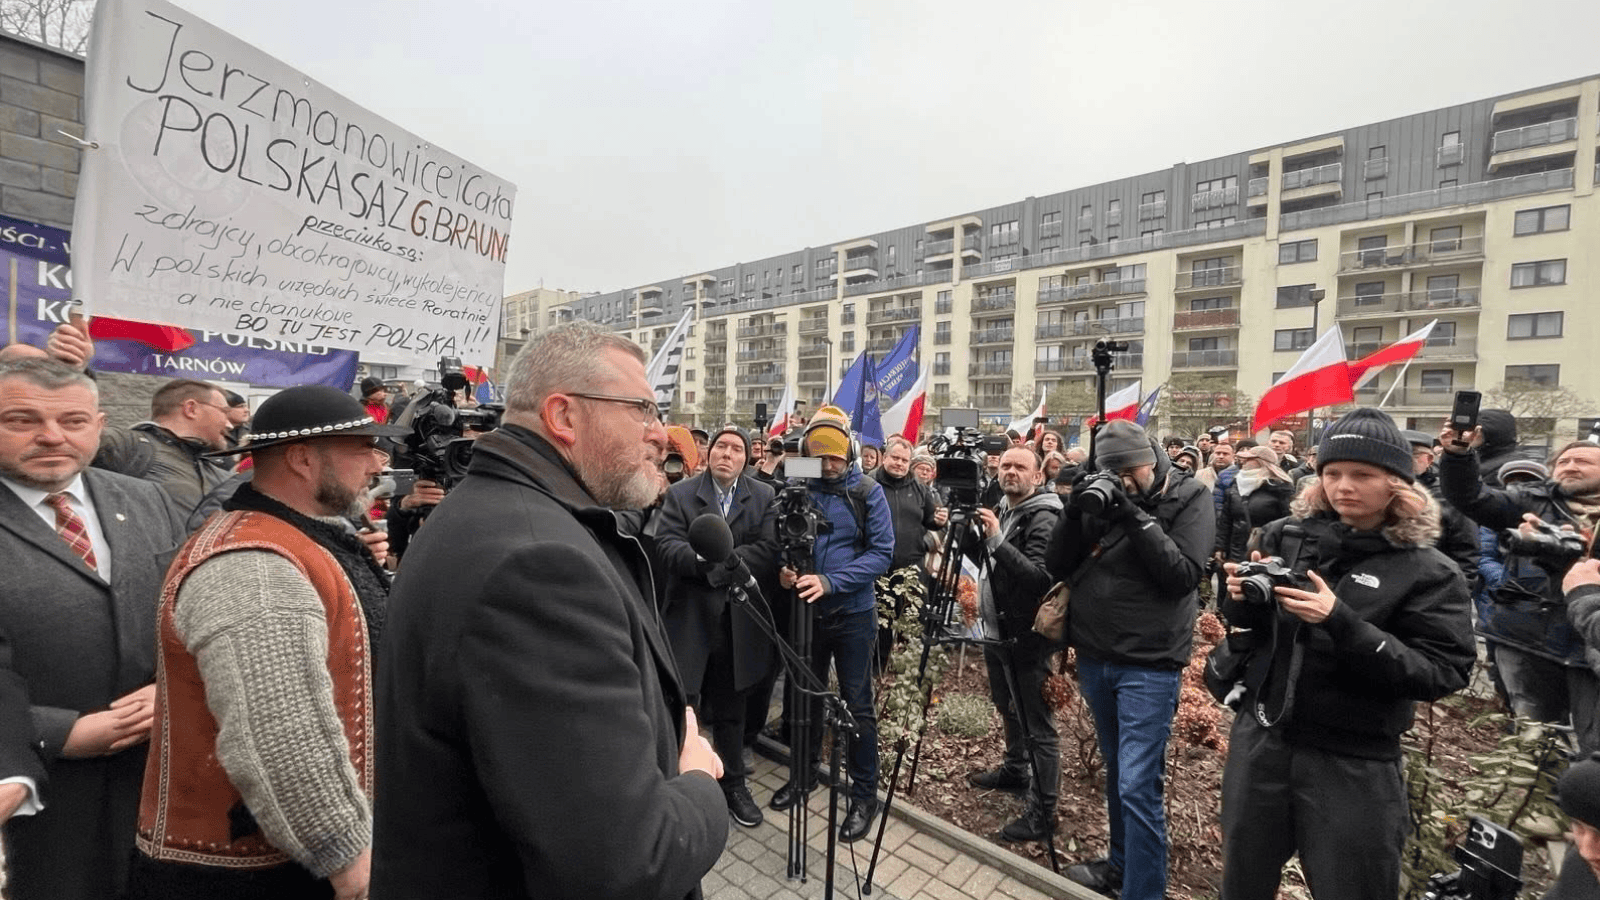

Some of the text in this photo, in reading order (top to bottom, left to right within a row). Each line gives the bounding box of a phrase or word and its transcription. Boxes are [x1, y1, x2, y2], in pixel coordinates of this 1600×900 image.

[127, 10, 453, 199] Jerzmanowice
[153, 95, 343, 211] POLSKA
[110, 232, 144, 272] W
[148, 252, 268, 287] polskich
[177, 293, 197, 305] a
[209, 295, 244, 311] nie
[235, 313, 269, 333] BO
[279, 319, 304, 336] TU
[305, 323, 362, 344] JEST
[152, 353, 246, 376] TARNÓW
